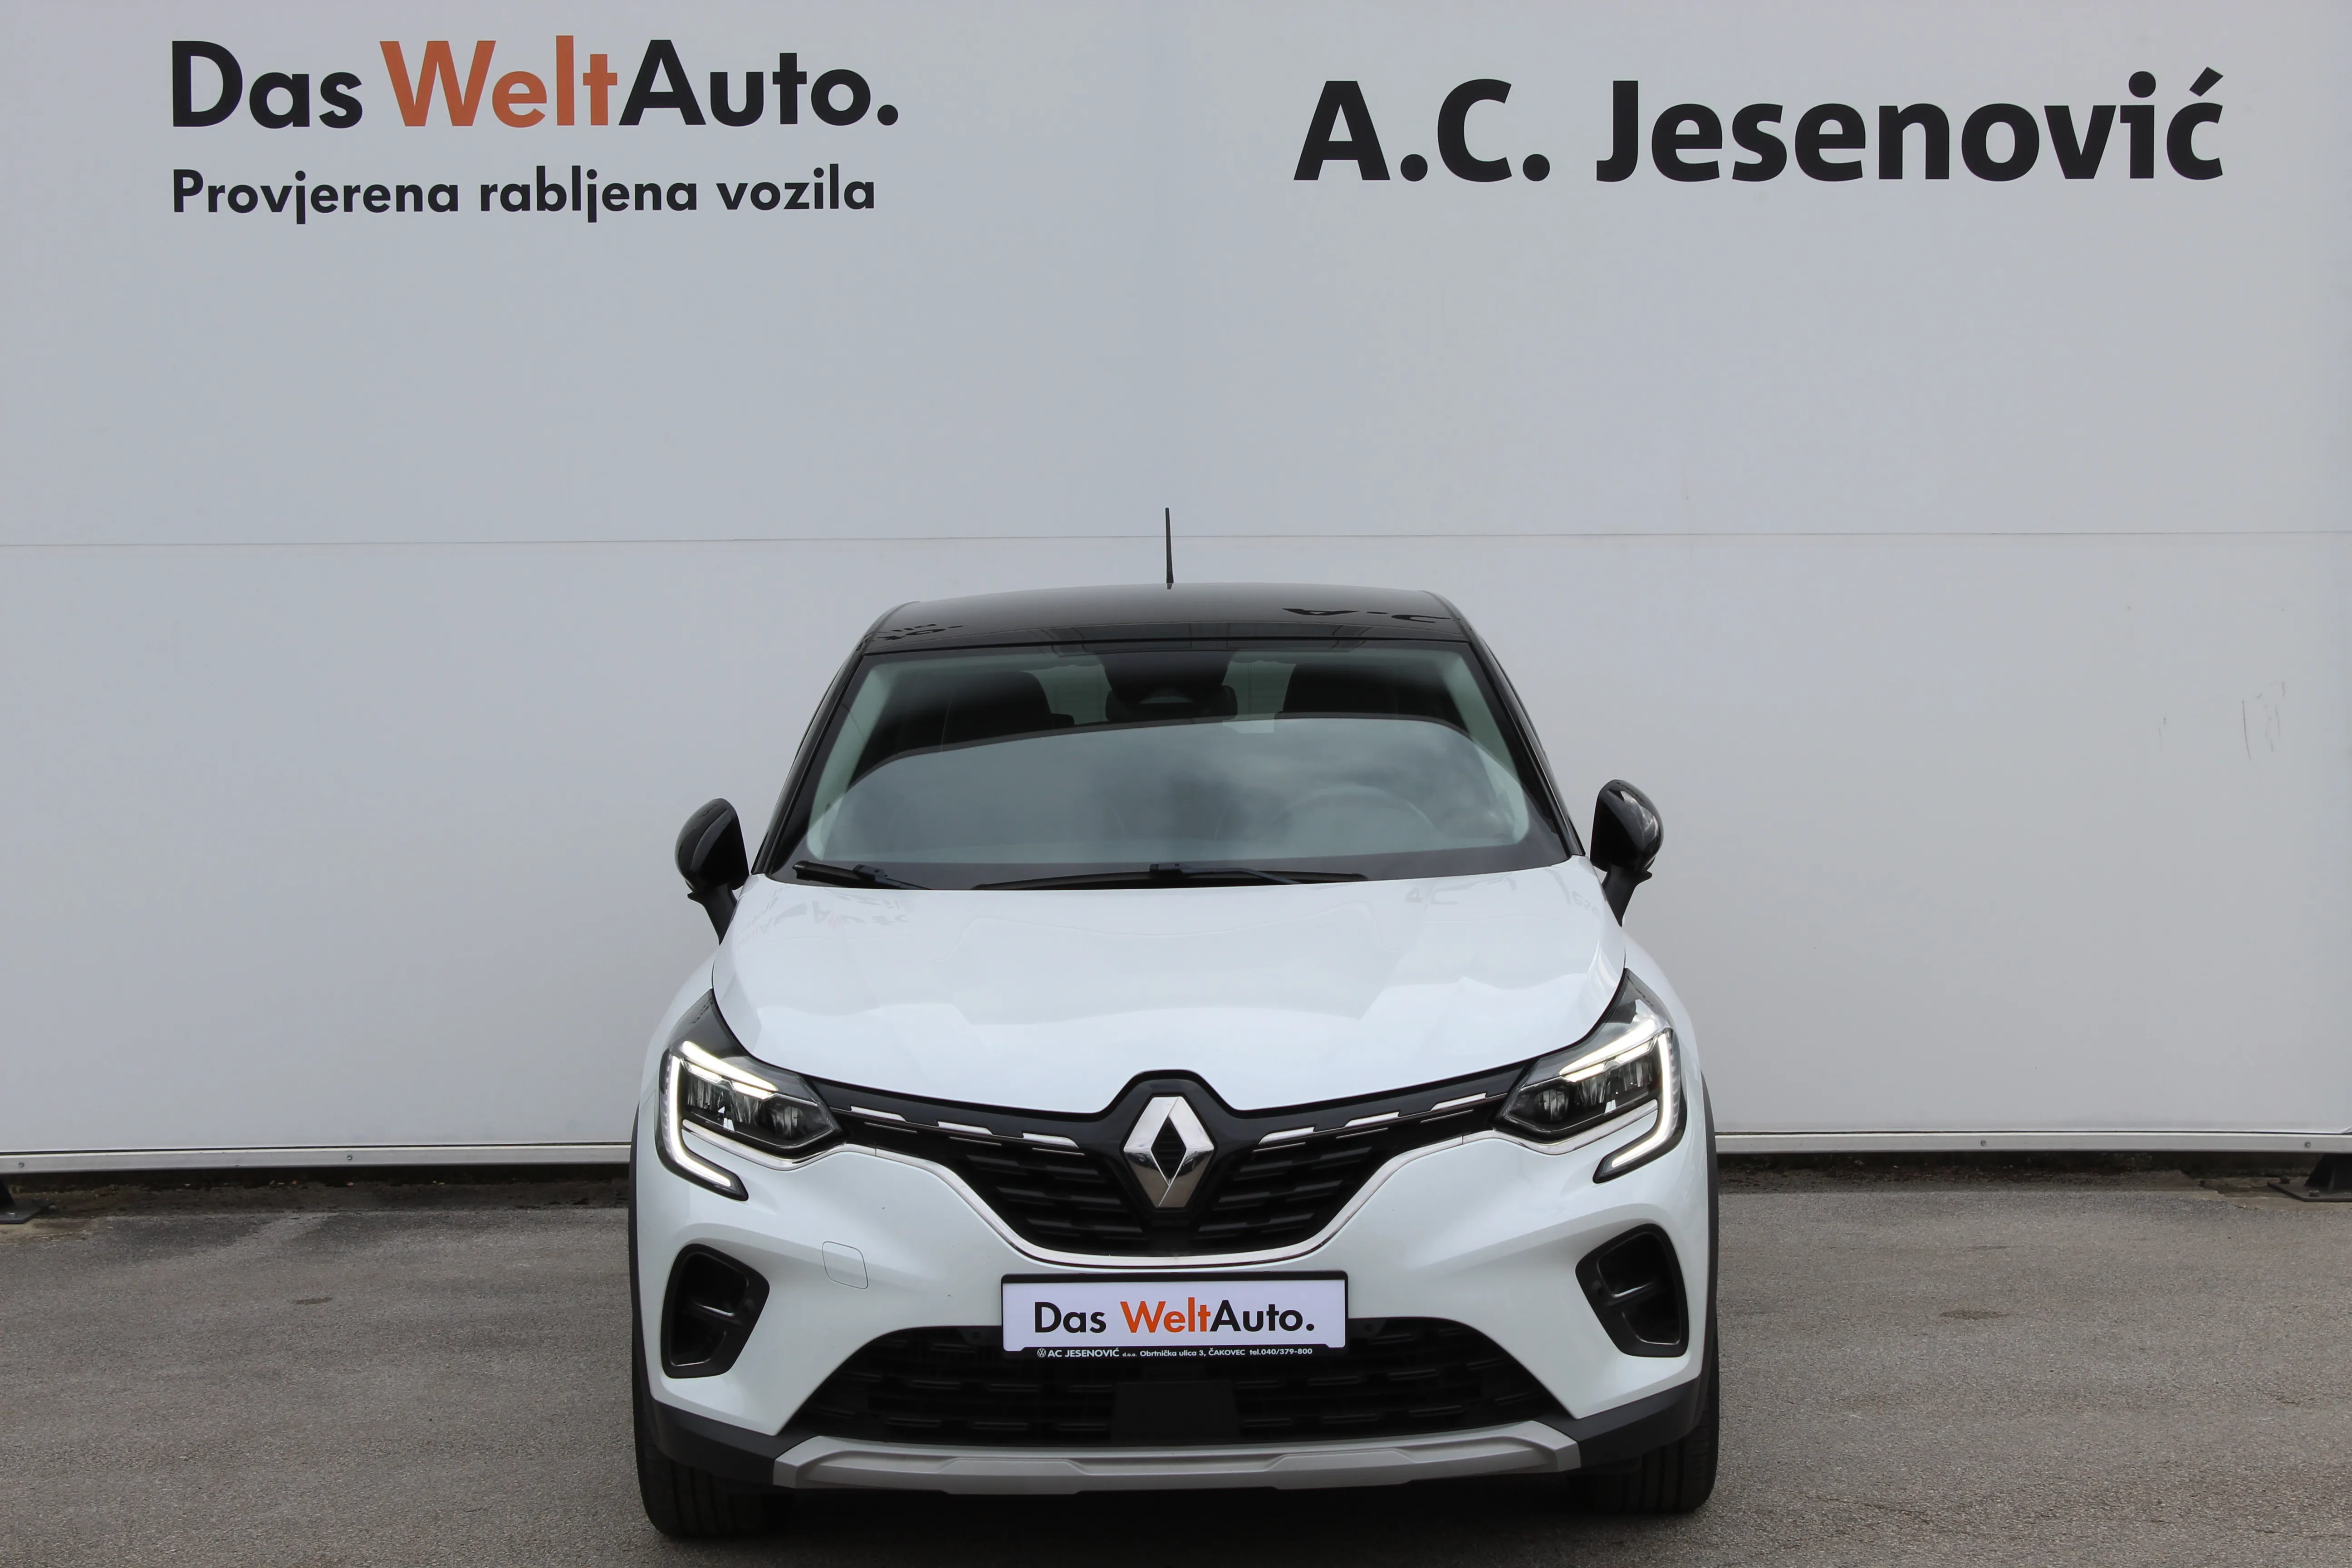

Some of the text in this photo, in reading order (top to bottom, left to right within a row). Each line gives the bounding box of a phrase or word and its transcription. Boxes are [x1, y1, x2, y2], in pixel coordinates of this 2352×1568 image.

[172, 35, 899, 129] Das WeltAuto.
[1293, 66, 2224, 183] A.C. Jesenović
[173, 163, 875, 225] Provjerena rabljena vozila
[1034, 1297, 1315, 1333] Das WeltAuto.
[1047, 1349, 1062, 1357] AC
[1064, 1348, 1120, 1357] JESENOVIĆ
[1208, 1348, 1245, 1356] ČAKOVEC
